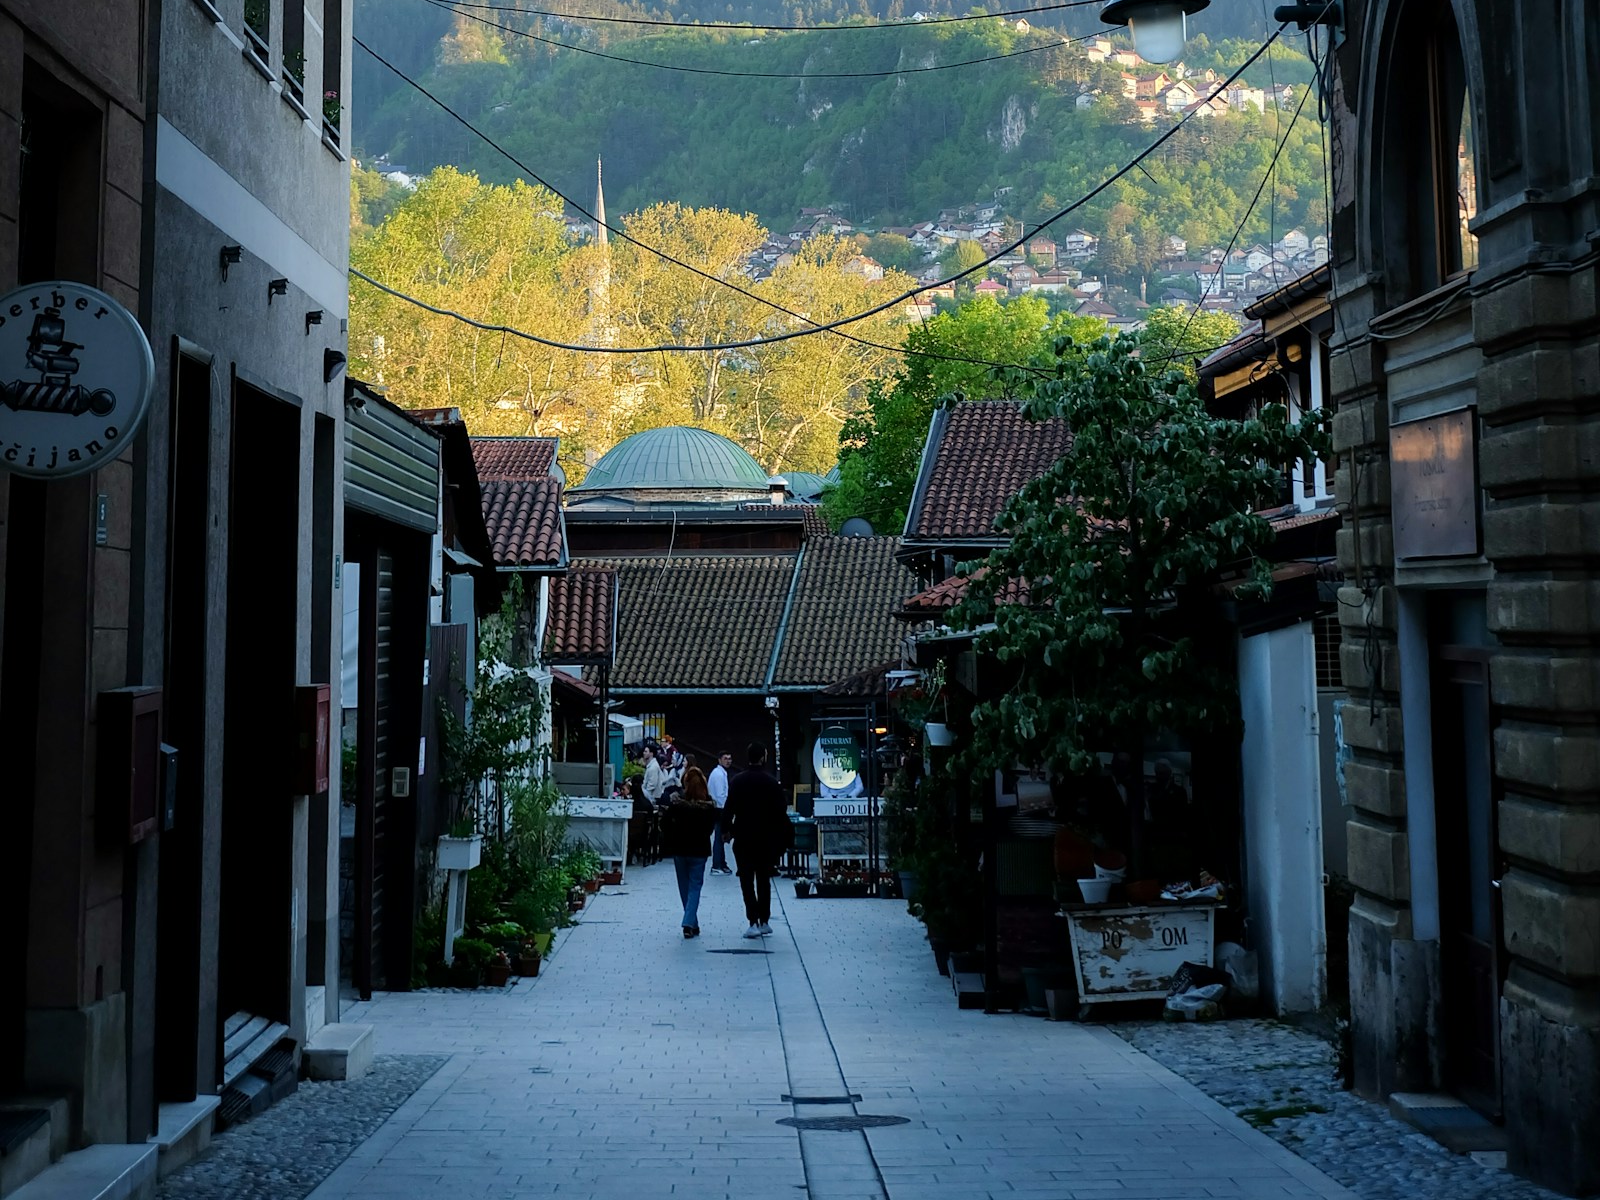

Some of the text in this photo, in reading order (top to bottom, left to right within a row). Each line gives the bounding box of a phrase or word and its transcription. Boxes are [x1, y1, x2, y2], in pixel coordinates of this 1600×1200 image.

[0, 426, 118, 469] čijano
[820, 737, 852, 745] RESTAURANT
[834, 804, 855, 815] POD
[1162, 927, 1188, 946] OM
